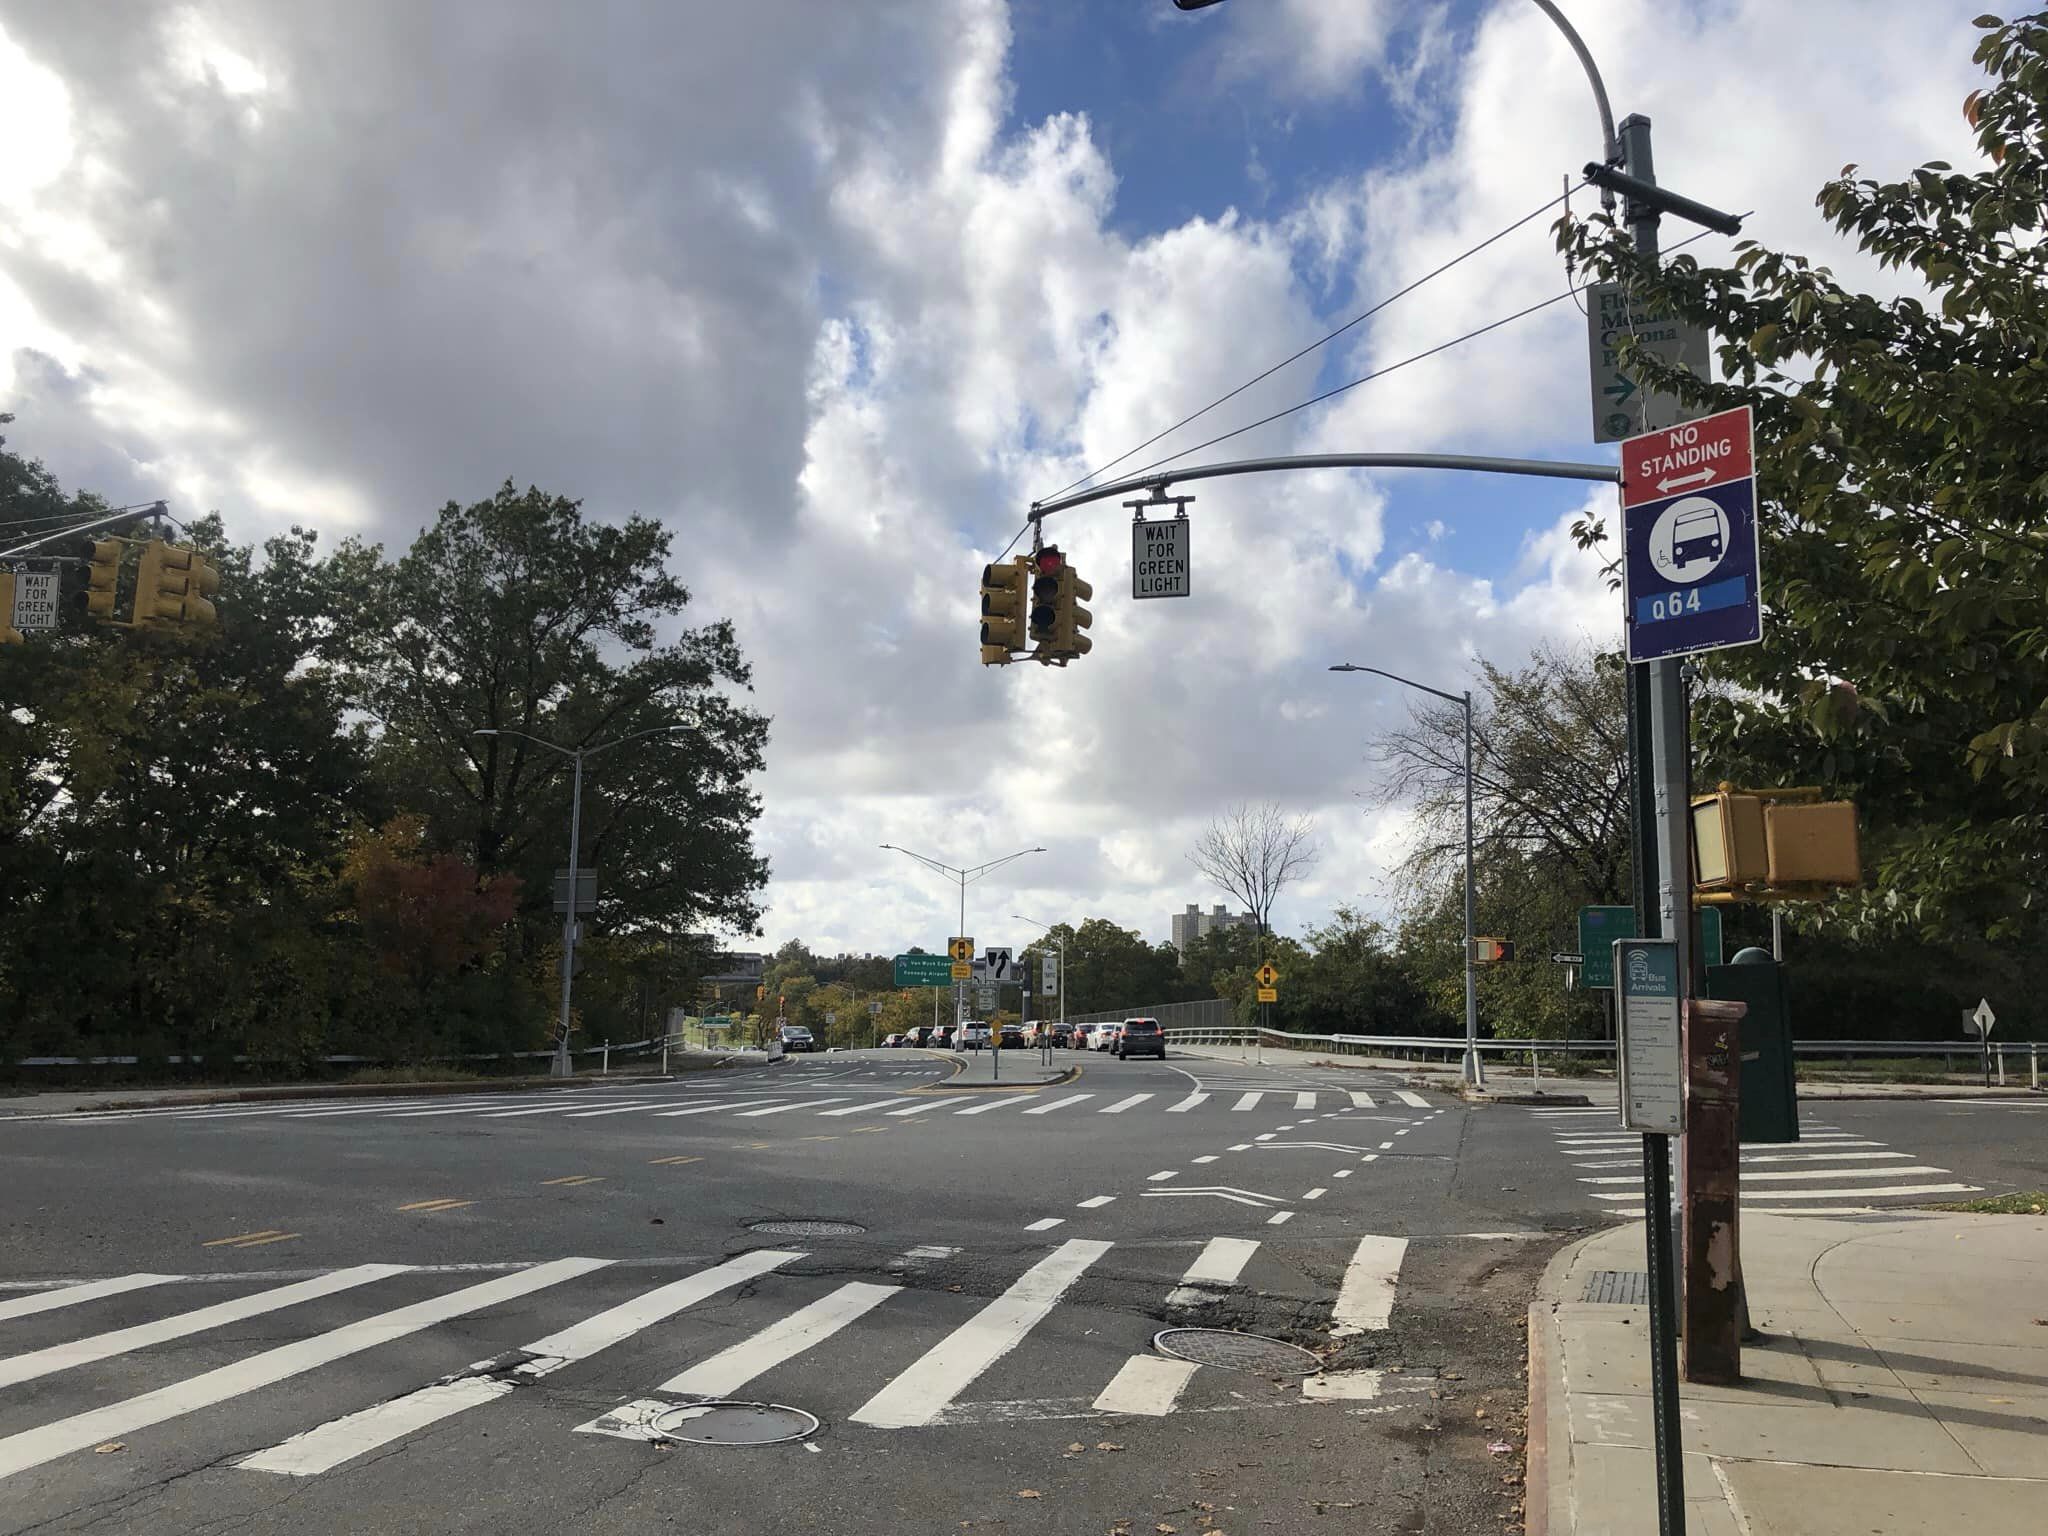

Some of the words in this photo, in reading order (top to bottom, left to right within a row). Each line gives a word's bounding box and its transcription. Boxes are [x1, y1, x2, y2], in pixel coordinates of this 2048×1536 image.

[1601, 329, 1678, 348] Cona
[1669, 426, 1698, 450] NO
[1641, 438, 1732, 478] STANDING
[1145, 525, 1177, 541] WAIT
[1147, 542, 1175, 558] FOR
[1138, 559, 1184, 576] GREEN
[25, 576, 51, 587] WAIT
[1141, 576, 1181, 593] LIGHT
[25, 588, 47, 600] FOR
[17, 601, 54, 612] GREEN
[1652, 587, 1702, 620] Q64
[18, 613, 51, 626] LIGHT
[1648, 973, 1667, 982] Bus
[1631, 983, 1667, 992] Arrivals
